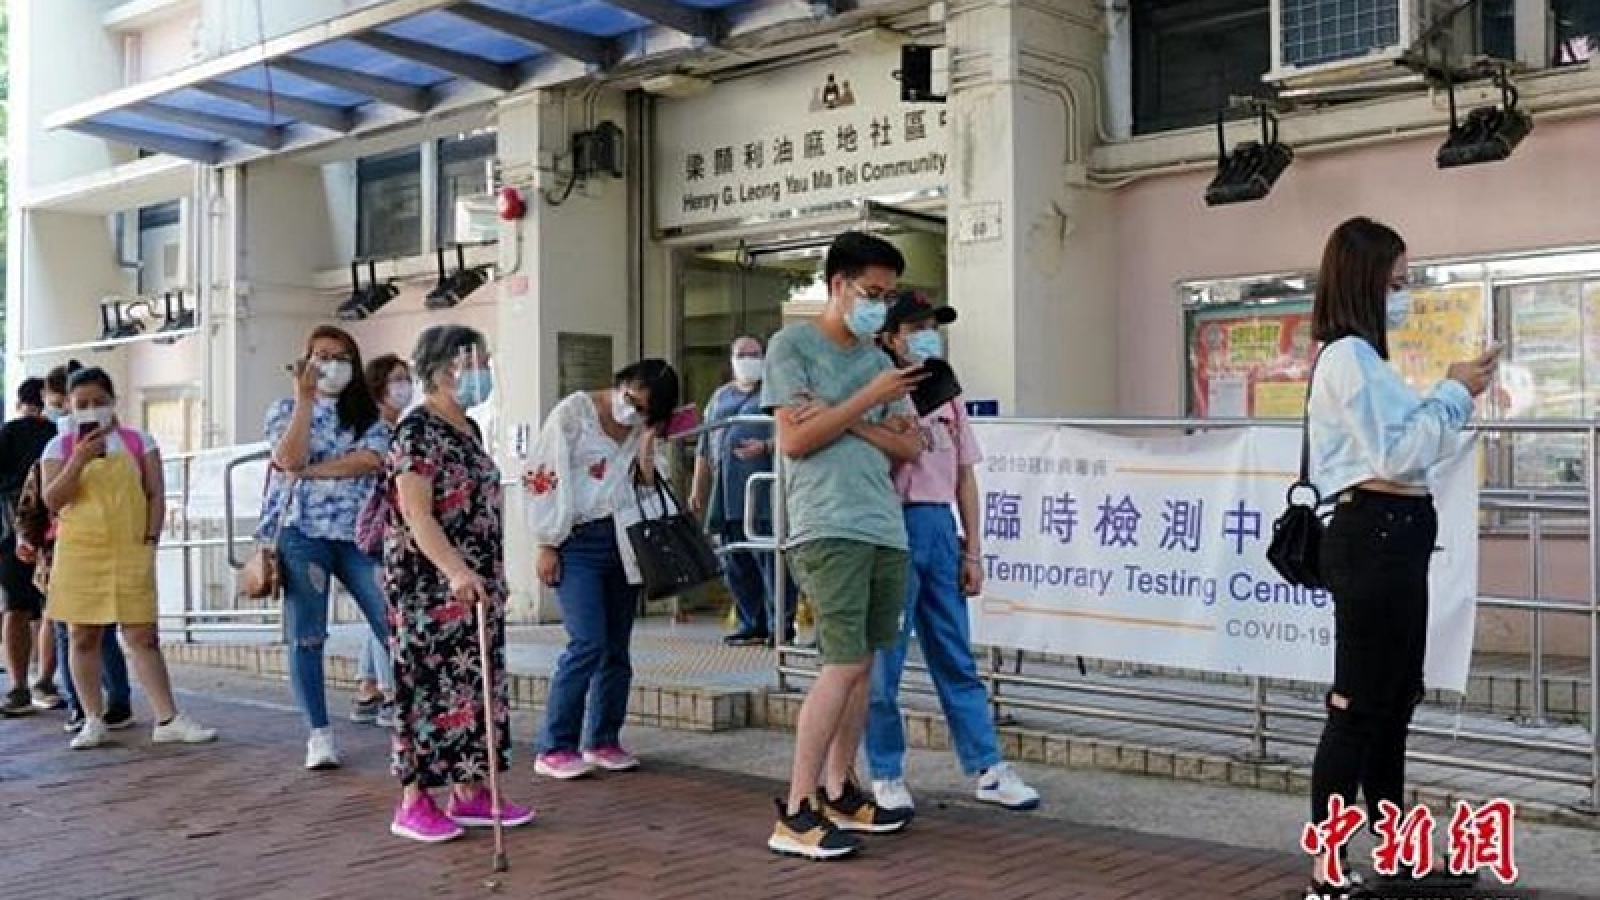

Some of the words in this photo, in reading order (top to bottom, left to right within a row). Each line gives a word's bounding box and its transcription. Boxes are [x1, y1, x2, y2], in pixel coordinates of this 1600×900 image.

[682, 193, 719, 212] Henry
[722, 186, 736, 206] G.
[740, 182, 781, 202] Leong
[786, 174, 809, 194] Yau
[813, 169, 833, 190] Ma
[837, 164, 857, 186] Tei
[861, 152, 946, 183] Community
[984, 490, 1262, 555] 臨時檢測中
[984, 554, 1113, 596] Temporary
[1124, 564, 1217, 606] Testing
[1229, 571, 1328, 608] Centre
[1226, 619, 1331, 647] COVID-19
